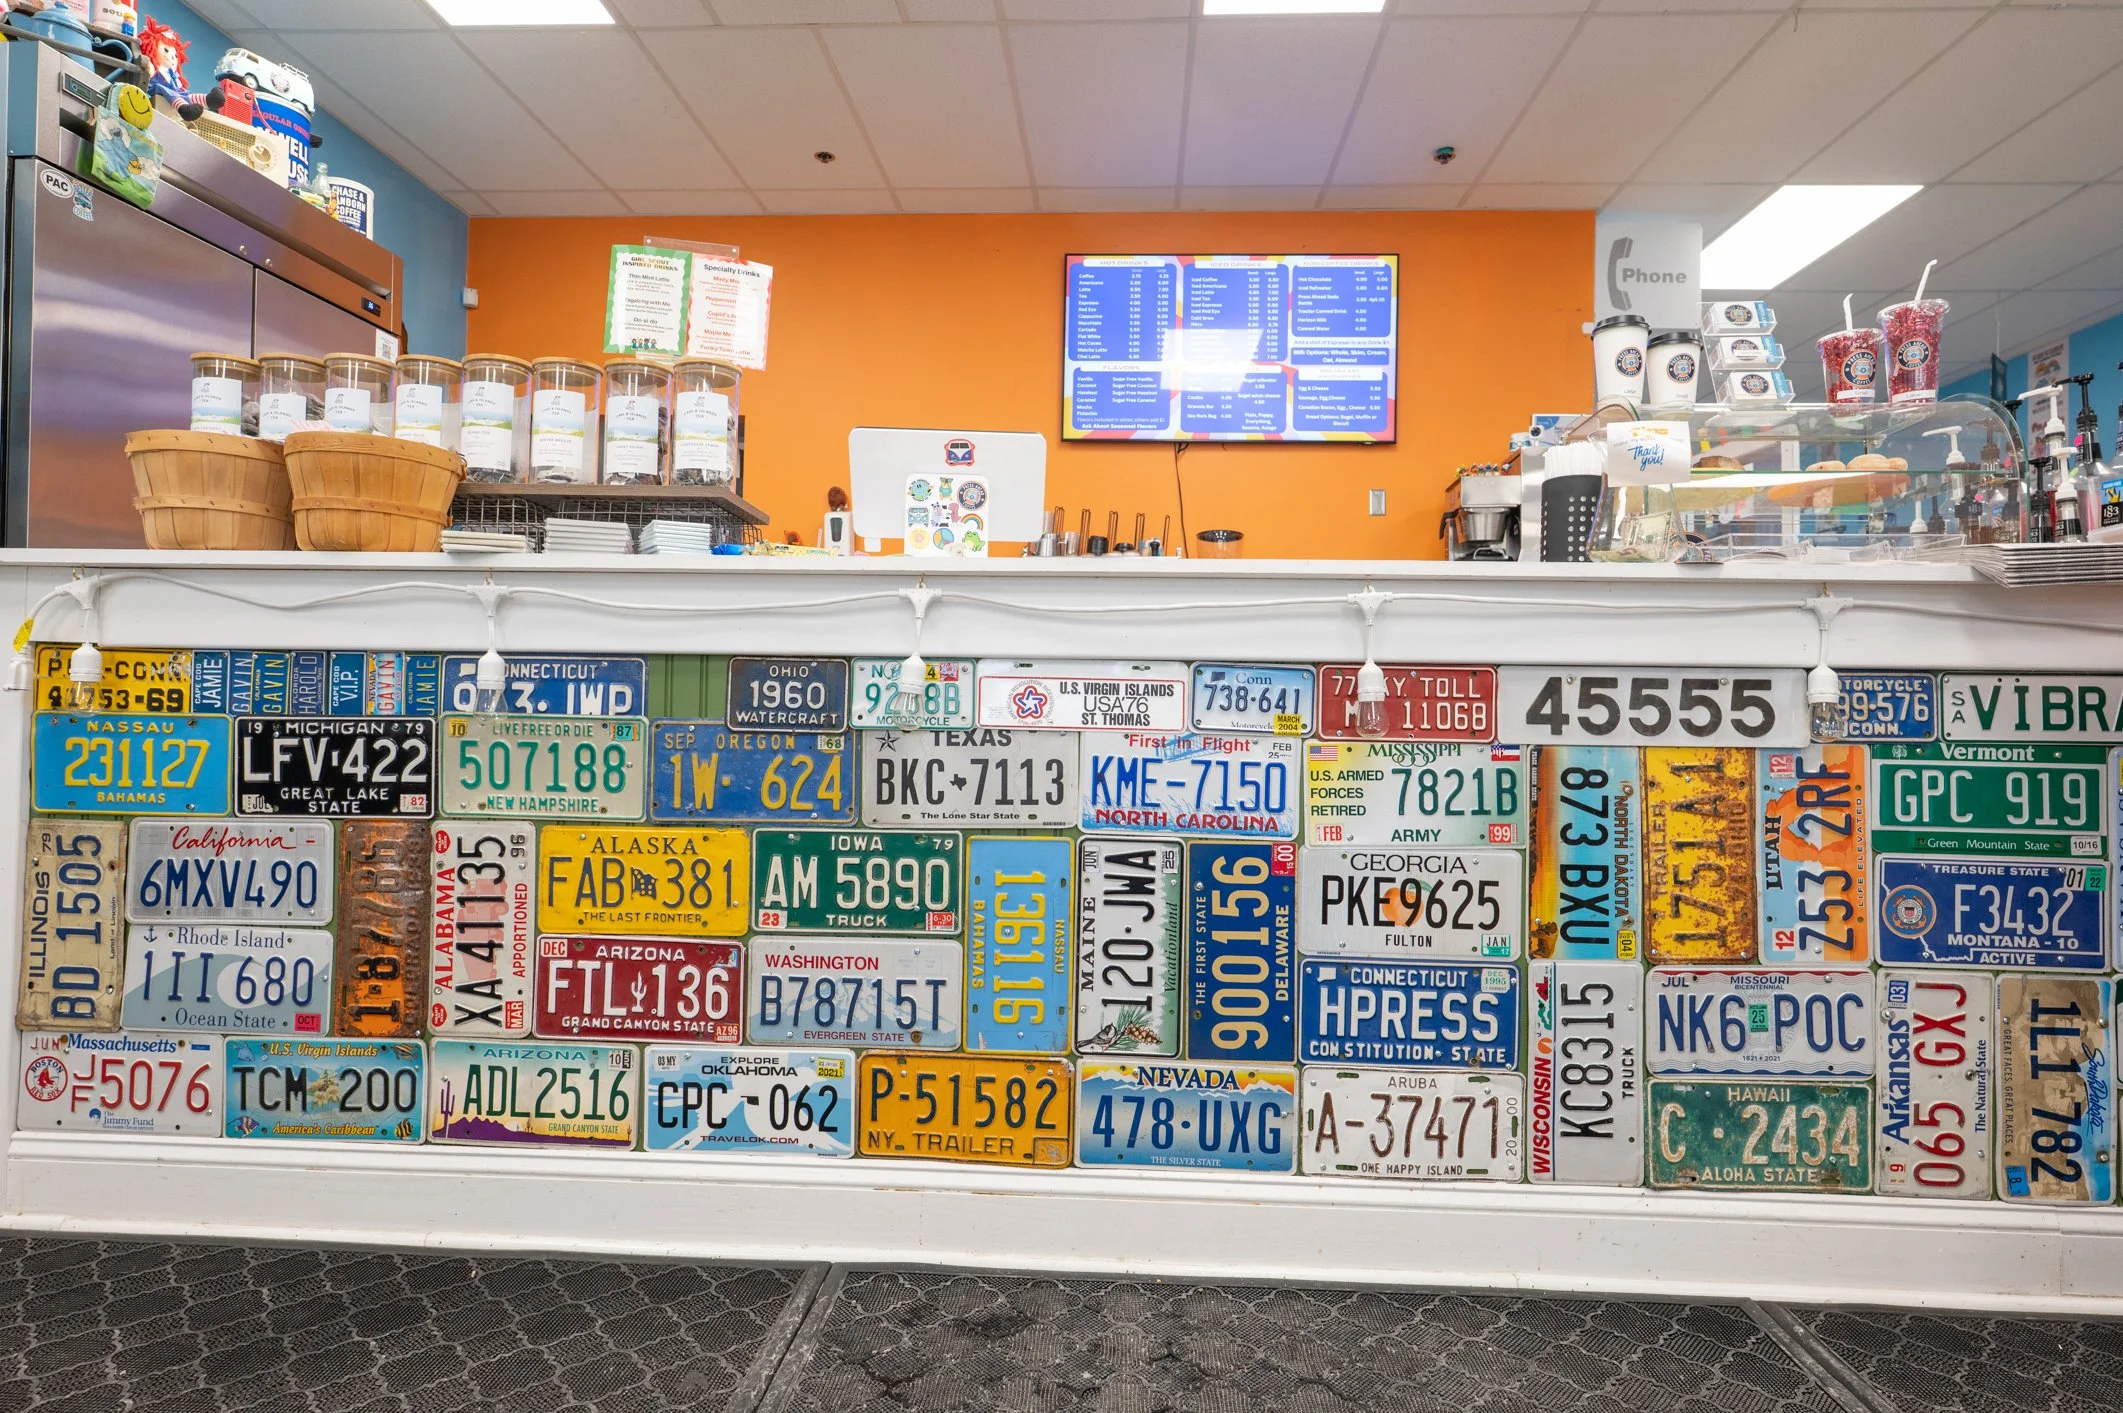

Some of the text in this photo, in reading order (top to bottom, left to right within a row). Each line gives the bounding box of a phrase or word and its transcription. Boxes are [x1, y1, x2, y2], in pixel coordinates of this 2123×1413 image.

[46, 175, 68, 191] PAC
[332, 185, 358, 199] CHASE
[704, 264, 761, 278] Specialty Drinks
[1622, 267, 1687, 285] Phone
[1627, 443, 1660, 460] Thank
[769, 666, 809, 678] OHIO
[1236, 673, 1272, 685] Conn
[202, 658, 223, 708] JAMIE
[263, 658, 284, 713] GAVIN
[299, 656, 317, 715] HAROLD
[1084, 682, 1174, 697] VIRGIN ISLANDS
[1420, 677, 1481, 698] TOLL
[750, 681, 825, 710] 1960
[1526, 676, 1776, 738] 45555
[87, 720, 174, 734] NASSAU
[736, 711, 839, 725] WATERCRAFT
[1101, 714, 1151, 726] THOMAS
[285, 723, 384, 735] MICHIGAN
[930, 729, 1012, 747] TEXAS
[664, 733, 795, 750] SEP OREGON
[1128, 734, 1250, 754] First Flight
[1940, 743, 2035, 761] Vermont
[64, 737, 210, 789] 231127
[459, 740, 626, 793] 507188
[761, 754, 842, 811] 624
[877, 758, 1064, 806] BKC 7113
[1092, 755, 1286, 813] KME-7150
[1310, 770, 1384, 781] U.S. ARMED
[96, 792, 166, 804] BAHAMAS
[280, 787, 389, 800] GREAT LAKE
[1311, 788, 1364, 798] FORCES
[1391, 767, 1518, 816] 7821B
[1894, 769, 2087, 826] GPC 919
[308, 801, 361, 813] STATE
[487, 796, 599, 813] NEW HAMPSHIRE
[1311, 805, 1366, 816] RETIRED
[1096, 809, 1279, 832] NORTH CAROLINA
[171, 825, 297, 857] California
[831, 836, 883, 851] IOWA
[1391, 829, 1442, 842] ARMY
[1927, 838, 2050, 851] Green Mountain State
[591, 836, 699, 855] ALASKA
[1766, 815, 1783, 890] UTAH
[1350, 852, 1468, 874] GEORGIA
[1614, 795, 1629, 919] NORTH DAKOTA
[1933, 864, 2049, 877] TREASURE STATE
[139, 858, 317, 909] 6MXV490
[547, 856, 733, 909] FAB 381
[764, 855, 949, 910] AM 5890
[1321, 874, 1500, 931] PKE9625
[1954, 883, 2074, 937] F3432
[29, 871, 50, 978] ILLINOIS
[583, 911, 702, 923] THE LAST FRONTIER
[826, 914, 888, 927] TRUCK
[177, 926, 285, 949] Rhode Island
[434, 867, 455, 990] ALABAMA
[513, 882, 528, 978] APPORTIONED
[543, 941, 565, 956] DEC
[971, 900, 986, 989] BAHAMAS
[1054, 919, 1064, 975] NASSAU
[1082, 897, 1096, 992] MAINE
[1385, 934, 1432, 948] FULTON
[1947, 934, 2040, 949] MONTANA
[595, 946, 685, 962] ARIZONA
[765, 954, 879, 970] WASHINGTON
[1275, 904, 1289, 1002] DELAWARE
[1979, 953, 2036, 965] ACTIVE
[1350, 968, 1469, 988] CONNECTICUT
[1730, 975, 1791, 986] MISSOURI
[760, 975, 947, 1031] B78715T
[174, 1007, 276, 1030] Ocean State
[1319, 987, 1499, 1042] HPRESS
[561, 1016, 714, 1033] GRAND CANYON STATE
[68, 1033, 177, 1053] Massachusetts
[804, 1030, 905, 1042] EVERGREEN STATE
[269, 1043, 378, 1059] U.S. Virgin Islands
[483, 1048, 586, 1061] ARIZONA
[30, 1058, 64, 1073] BOSTON
[720, 1056, 780, 1065] EXPLORE
[701, 1065, 798, 1077] OKLAHOMA
[1137, 1066, 1240, 1090] NEVADA
[1622, 1046, 1634, 1099] TRUCK
[233, 1066, 417, 1112] TCM 200
[1387, 1076, 1437, 1089] ARUBA
[1882, 1019, 1910, 1145] Arkansas
[463, 1064, 630, 1122] ADL2516
[1727, 1088, 1791, 1103] HAWAII
[658, 1081, 838, 1133] CPC 062
[1533, 1056, 1552, 1175] WISCONSIN
[272, 1122, 376, 1135] America's Caribbean
[548, 1123, 619, 1134] GRAND CANYON STATE
[868, 1130, 1014, 1154] NY TRAILER
[1168, 1156, 1195, 1166] SILVER
[1386, 1163, 1463, 1175] HAPPY ISLAND
[1701, 1167, 1818, 1183] ALOHA STATE
